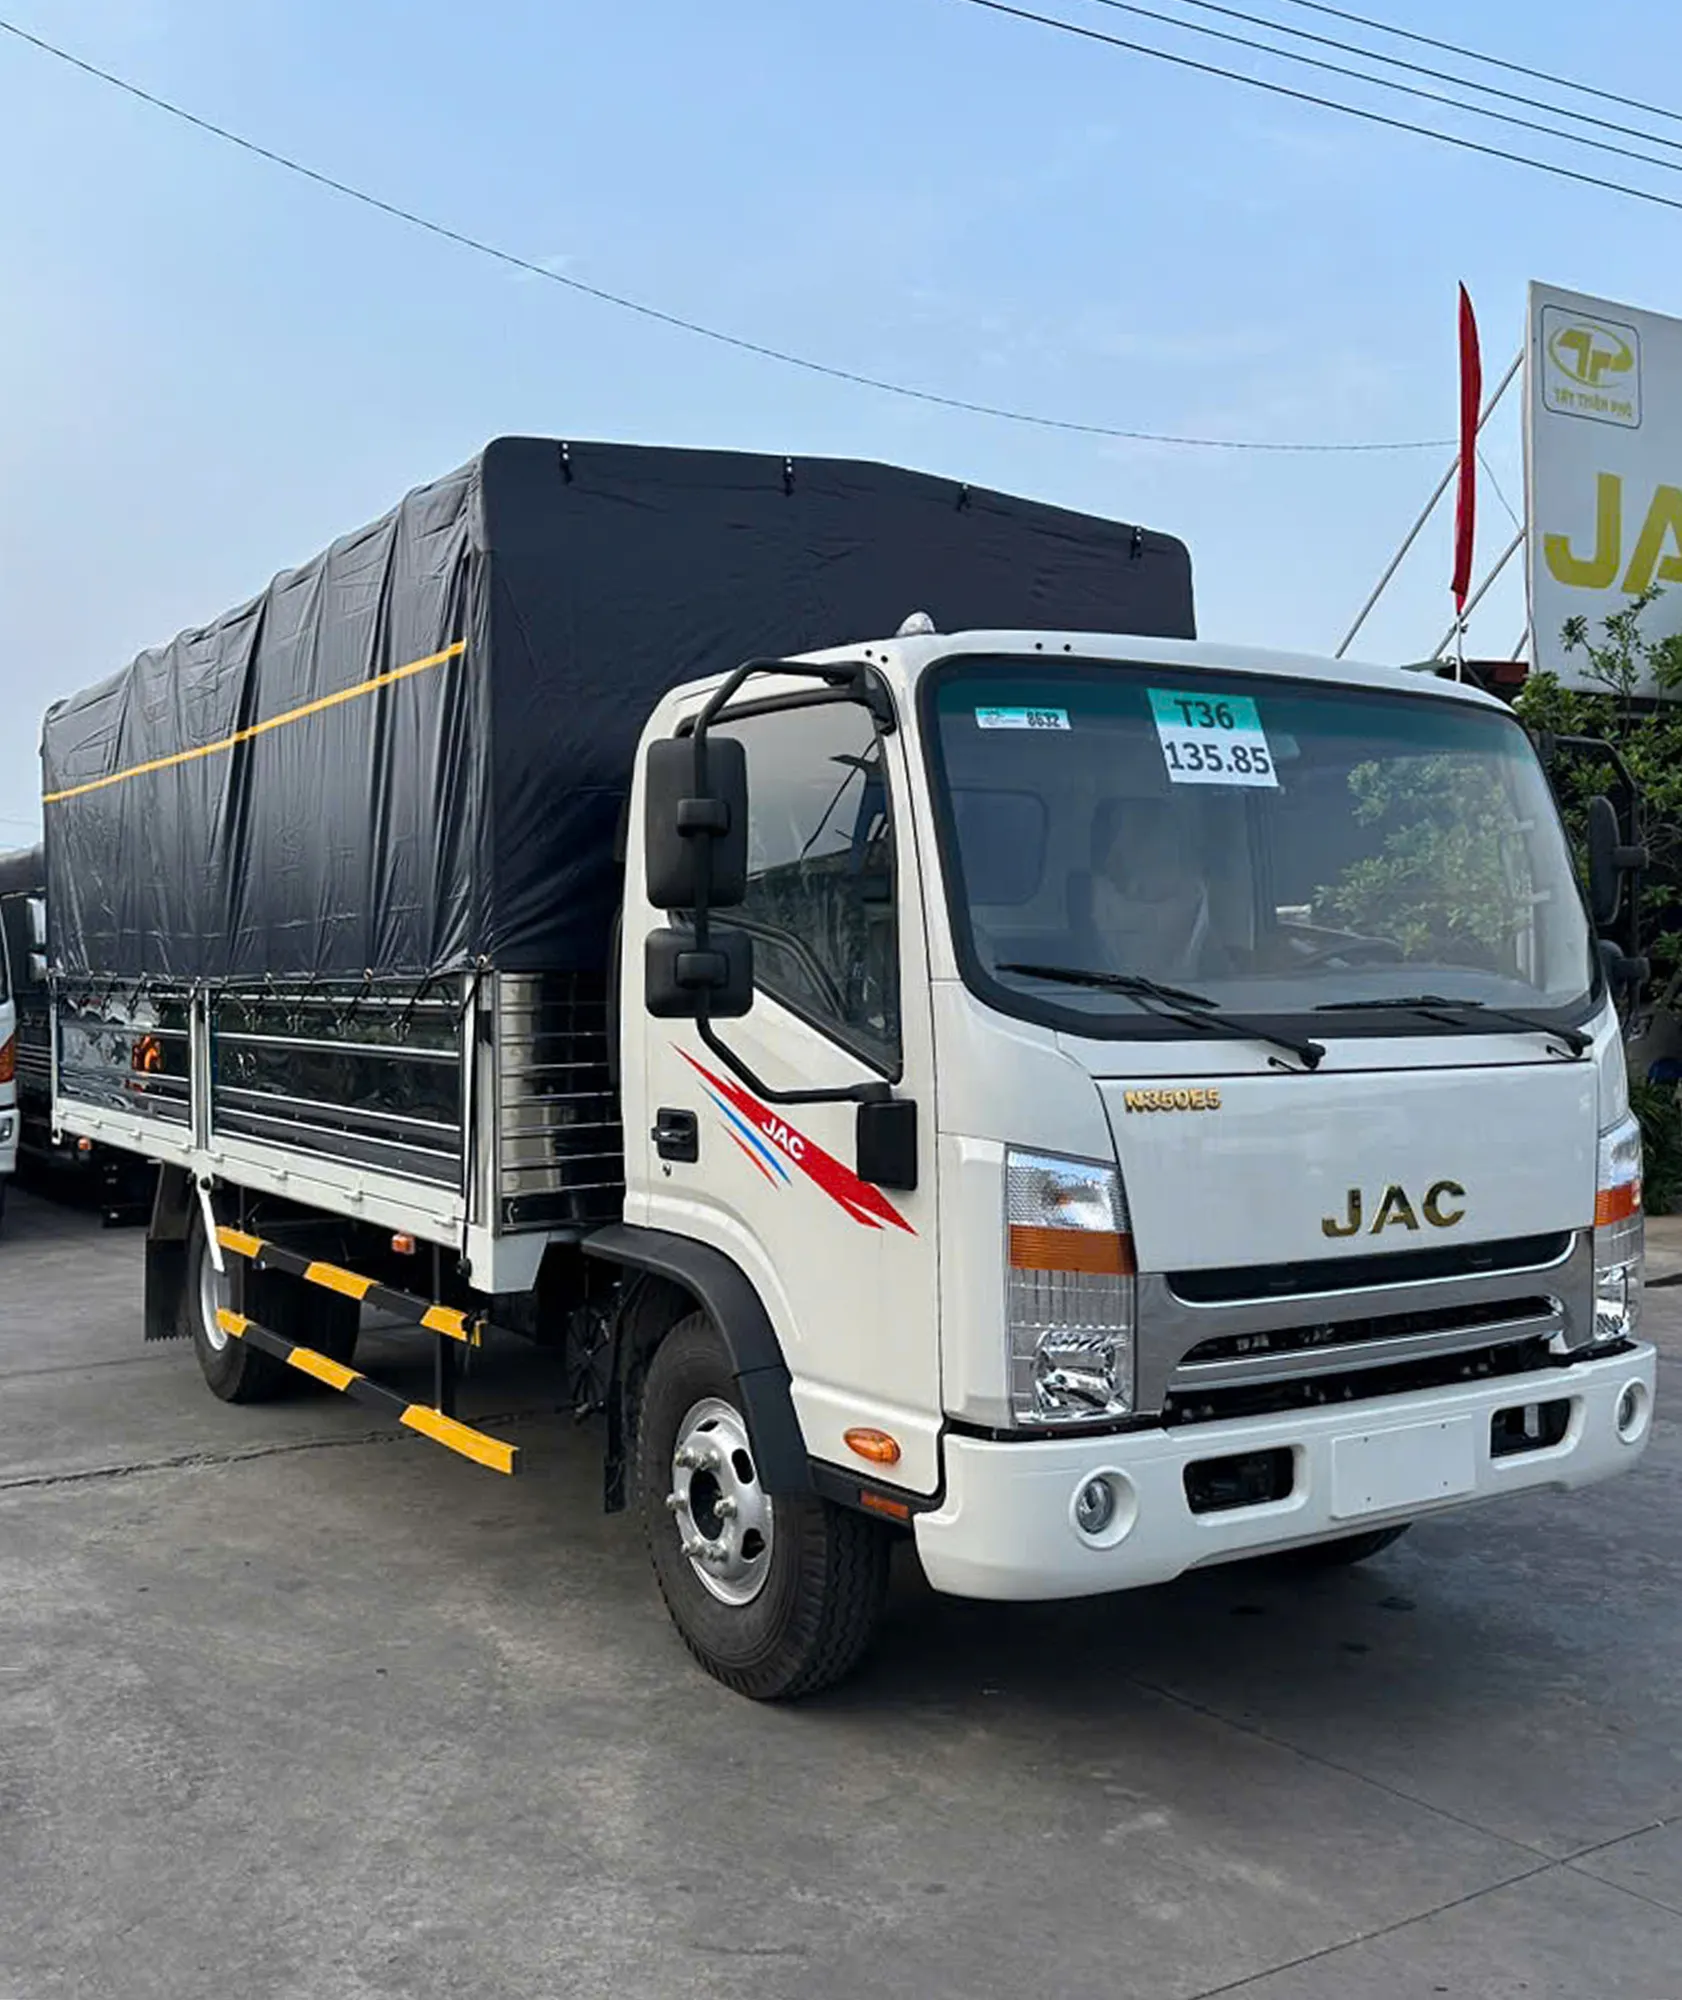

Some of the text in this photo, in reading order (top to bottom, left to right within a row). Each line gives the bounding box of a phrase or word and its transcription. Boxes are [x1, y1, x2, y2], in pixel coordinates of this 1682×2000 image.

[1173, 699, 1235, 730] T36
[1165, 741, 1271, 774] 135.85
[761, 1117, 805, 1160] JAC
[1321, 1179, 1467, 1238] JAC
